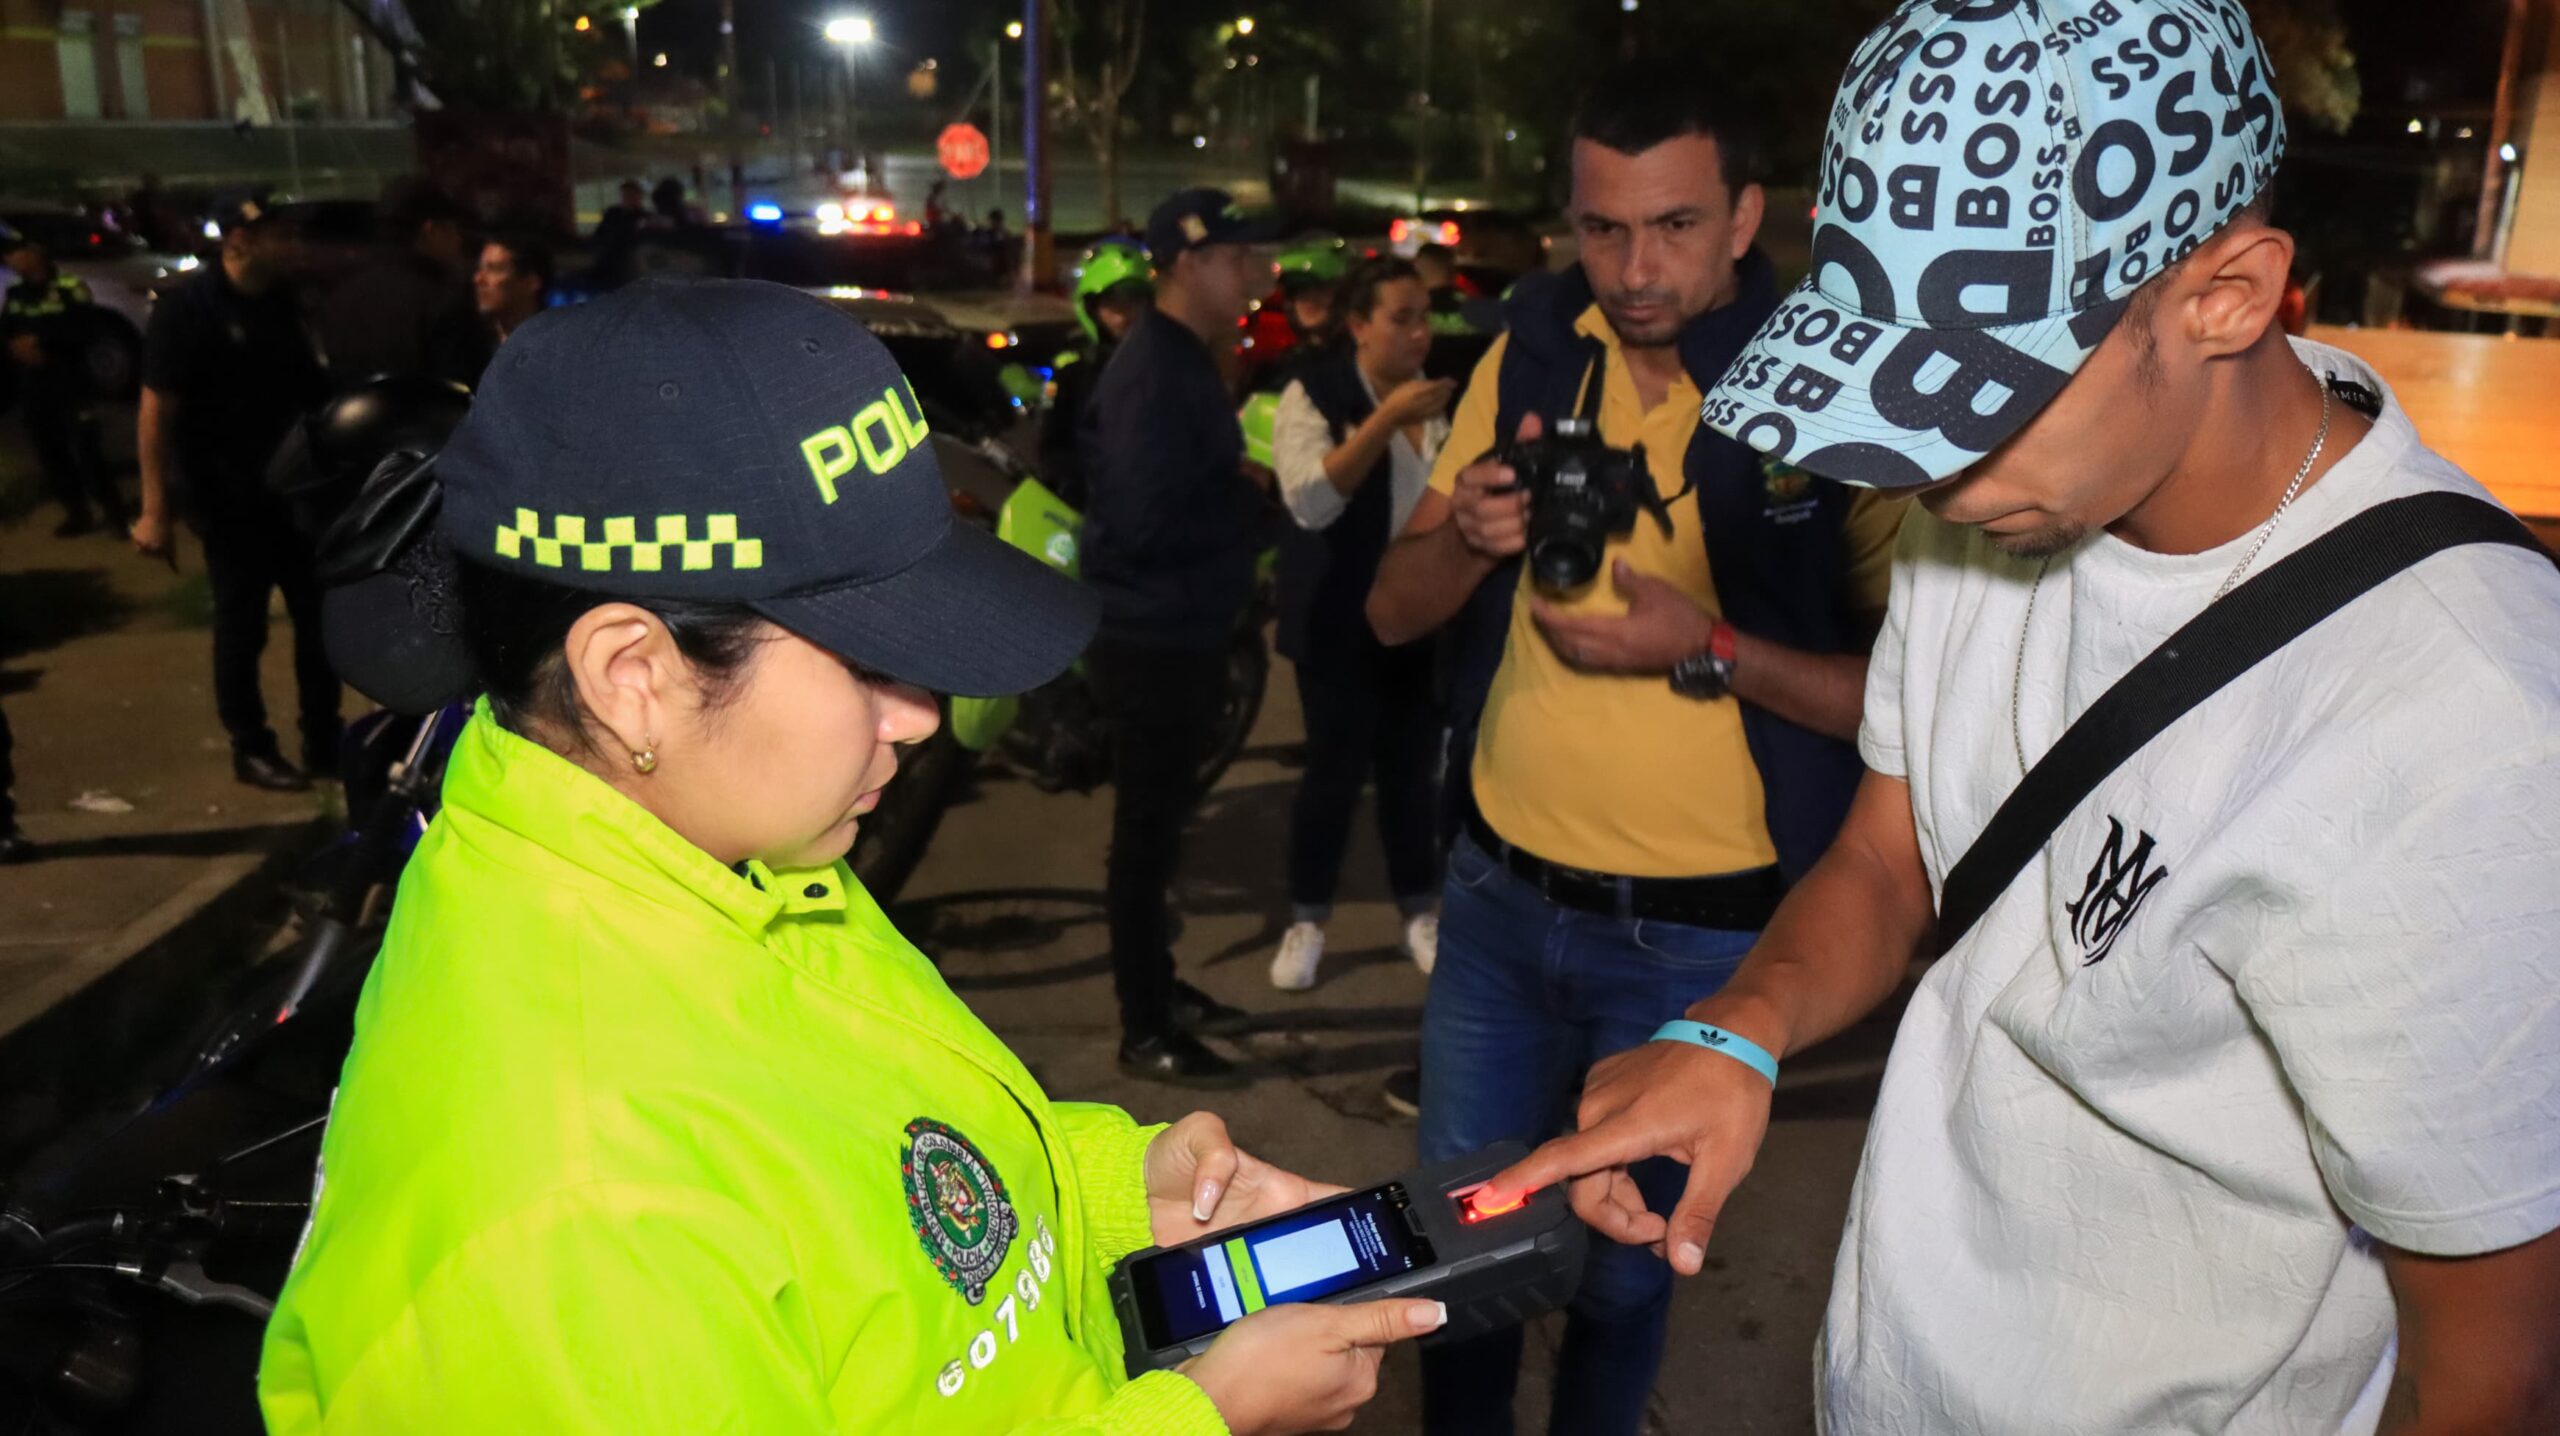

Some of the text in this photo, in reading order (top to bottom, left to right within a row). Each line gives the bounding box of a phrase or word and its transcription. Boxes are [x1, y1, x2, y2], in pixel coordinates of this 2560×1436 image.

[2043, 2, 2123, 56] BOSS
[1954, 40, 2041, 229] BOSS
[2026, 144, 2067, 247] BOSS
[1755, 303, 1885, 366] BOSS
[800, 374, 930, 506] POL
